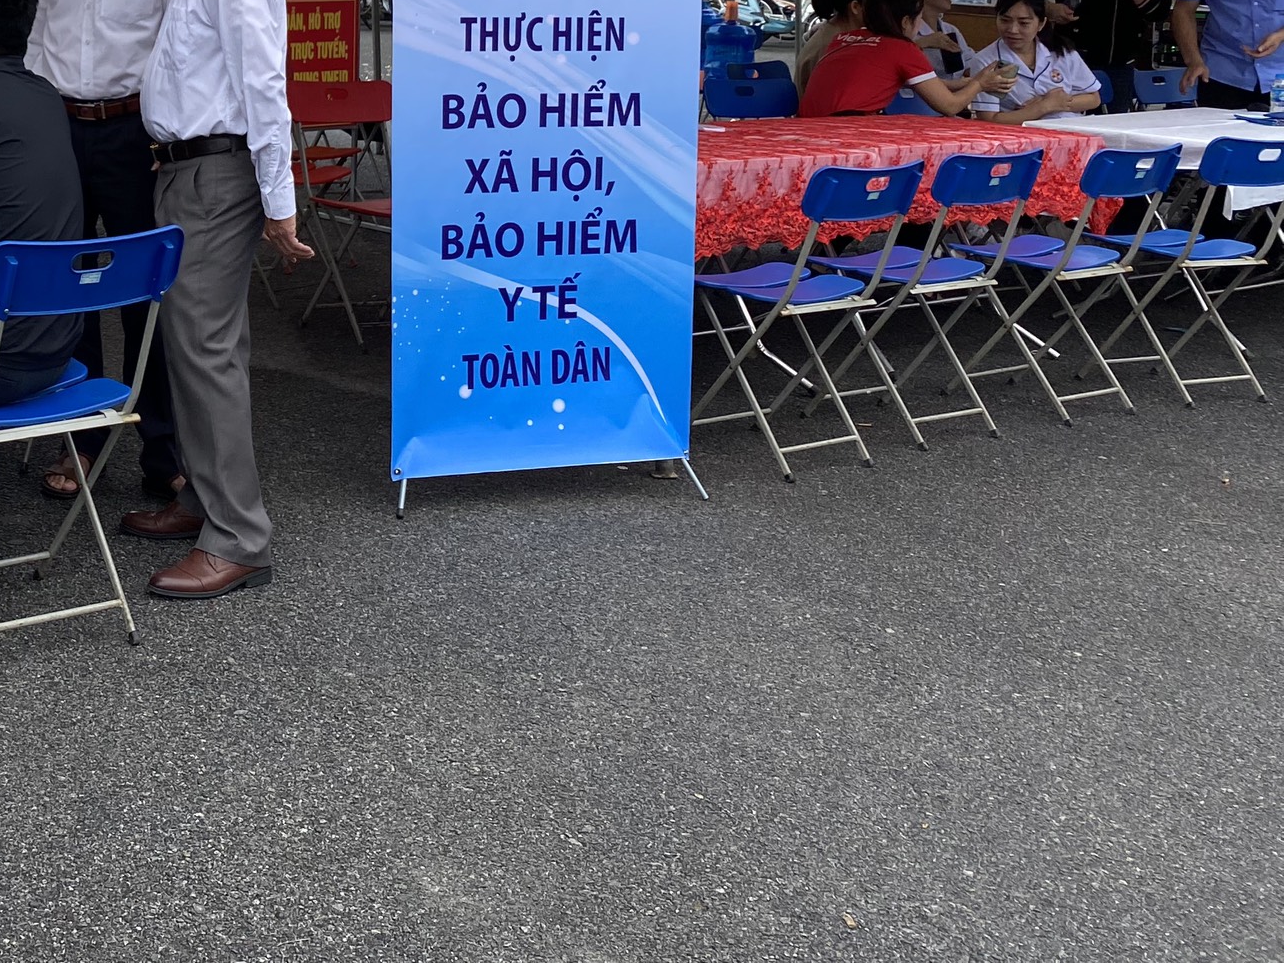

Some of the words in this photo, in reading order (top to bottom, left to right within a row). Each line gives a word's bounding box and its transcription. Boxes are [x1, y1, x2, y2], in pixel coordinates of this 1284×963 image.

[287, 6, 306, 32] ẪN,
[323, 11, 341, 33] TRỢ
[460, 12, 544, 62] THỰC
[552, 10, 625, 62] HIỆN
[290, 40, 315, 63] TRỰC
[442, 82, 527, 130] BẢO
[539, 79, 641, 128] HIỂM
[464, 149, 519, 194] XÃ
[531, 149, 615, 202] HỘI,
[441, 212, 525, 260] BẢO
[536, 207, 637, 256] HIỂM
[498, 286, 524, 322] Y
[532, 272, 582, 321] TẾ
[462, 345, 541, 390] TOÀN
[551, 340, 611, 385] DÂN
